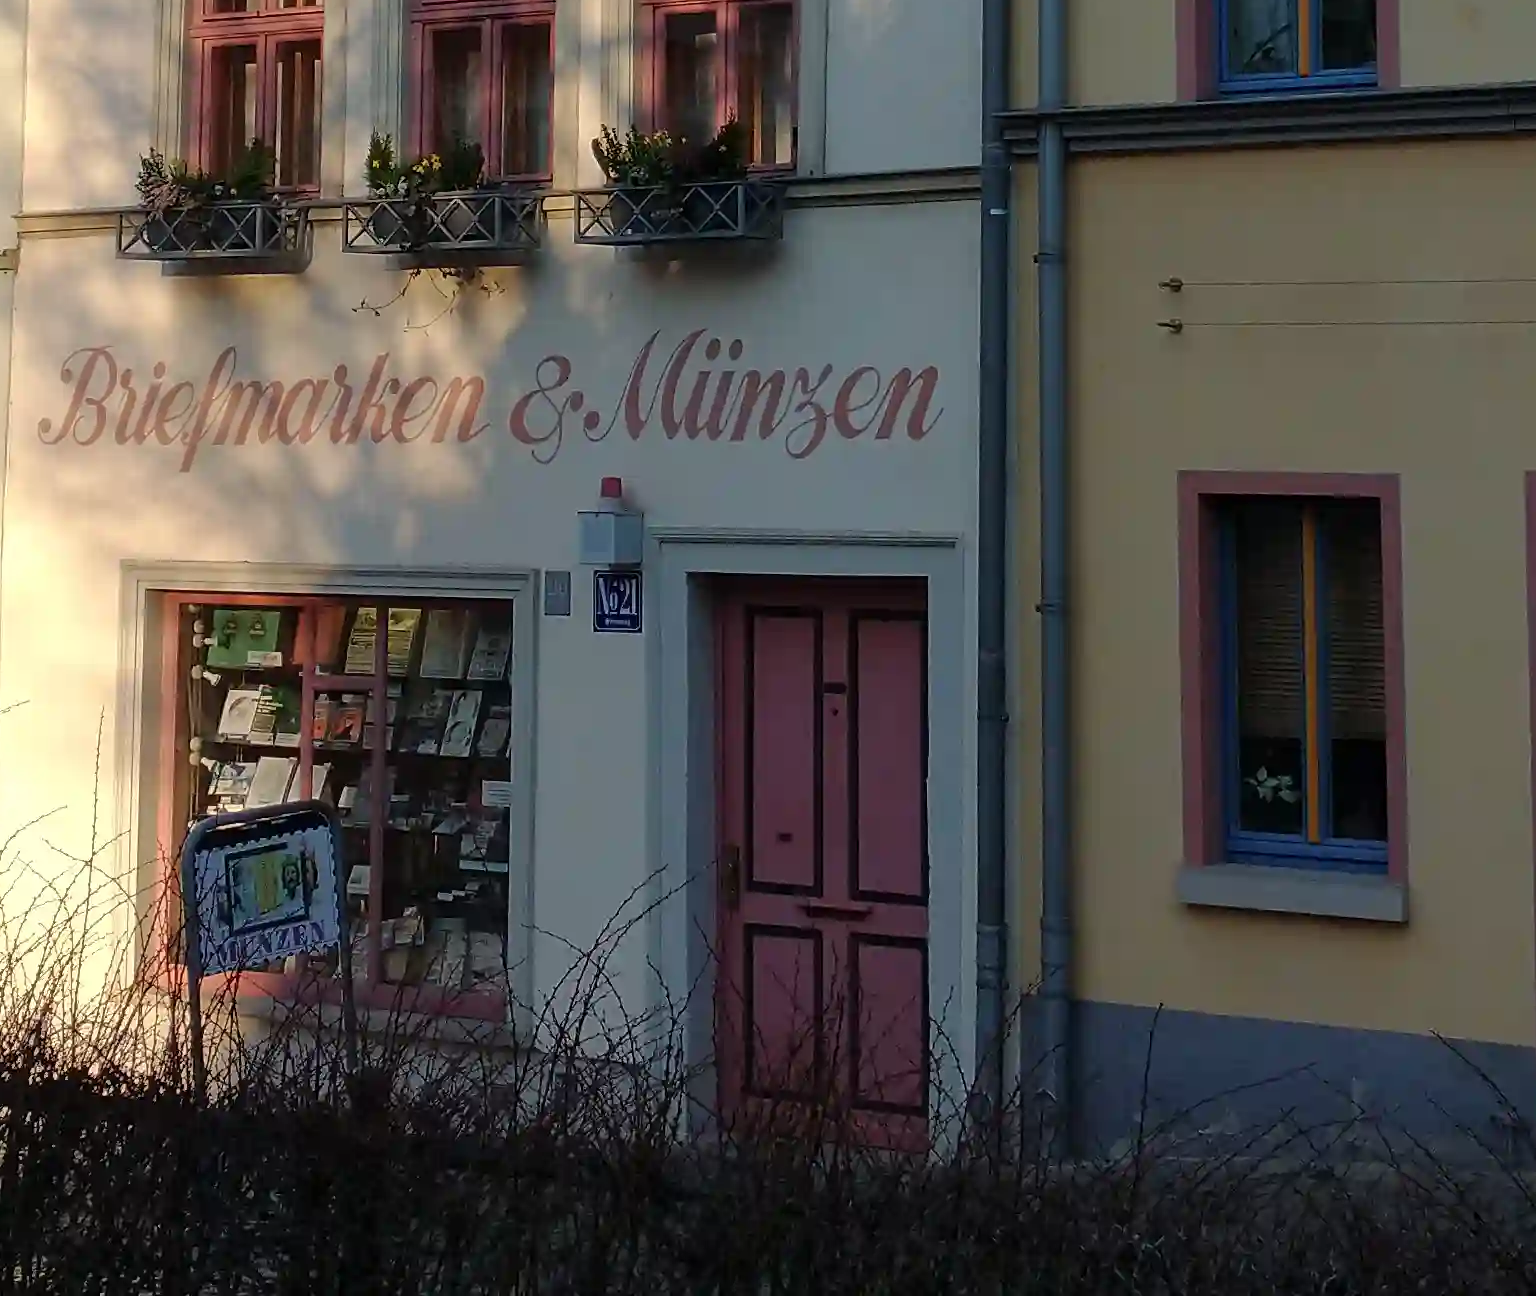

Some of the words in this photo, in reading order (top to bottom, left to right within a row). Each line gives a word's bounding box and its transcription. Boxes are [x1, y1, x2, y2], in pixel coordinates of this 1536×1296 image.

[38, 345, 491, 473] Briefmarken
[509, 355, 584, 464] &
[583, 328, 944, 459] Münzen
